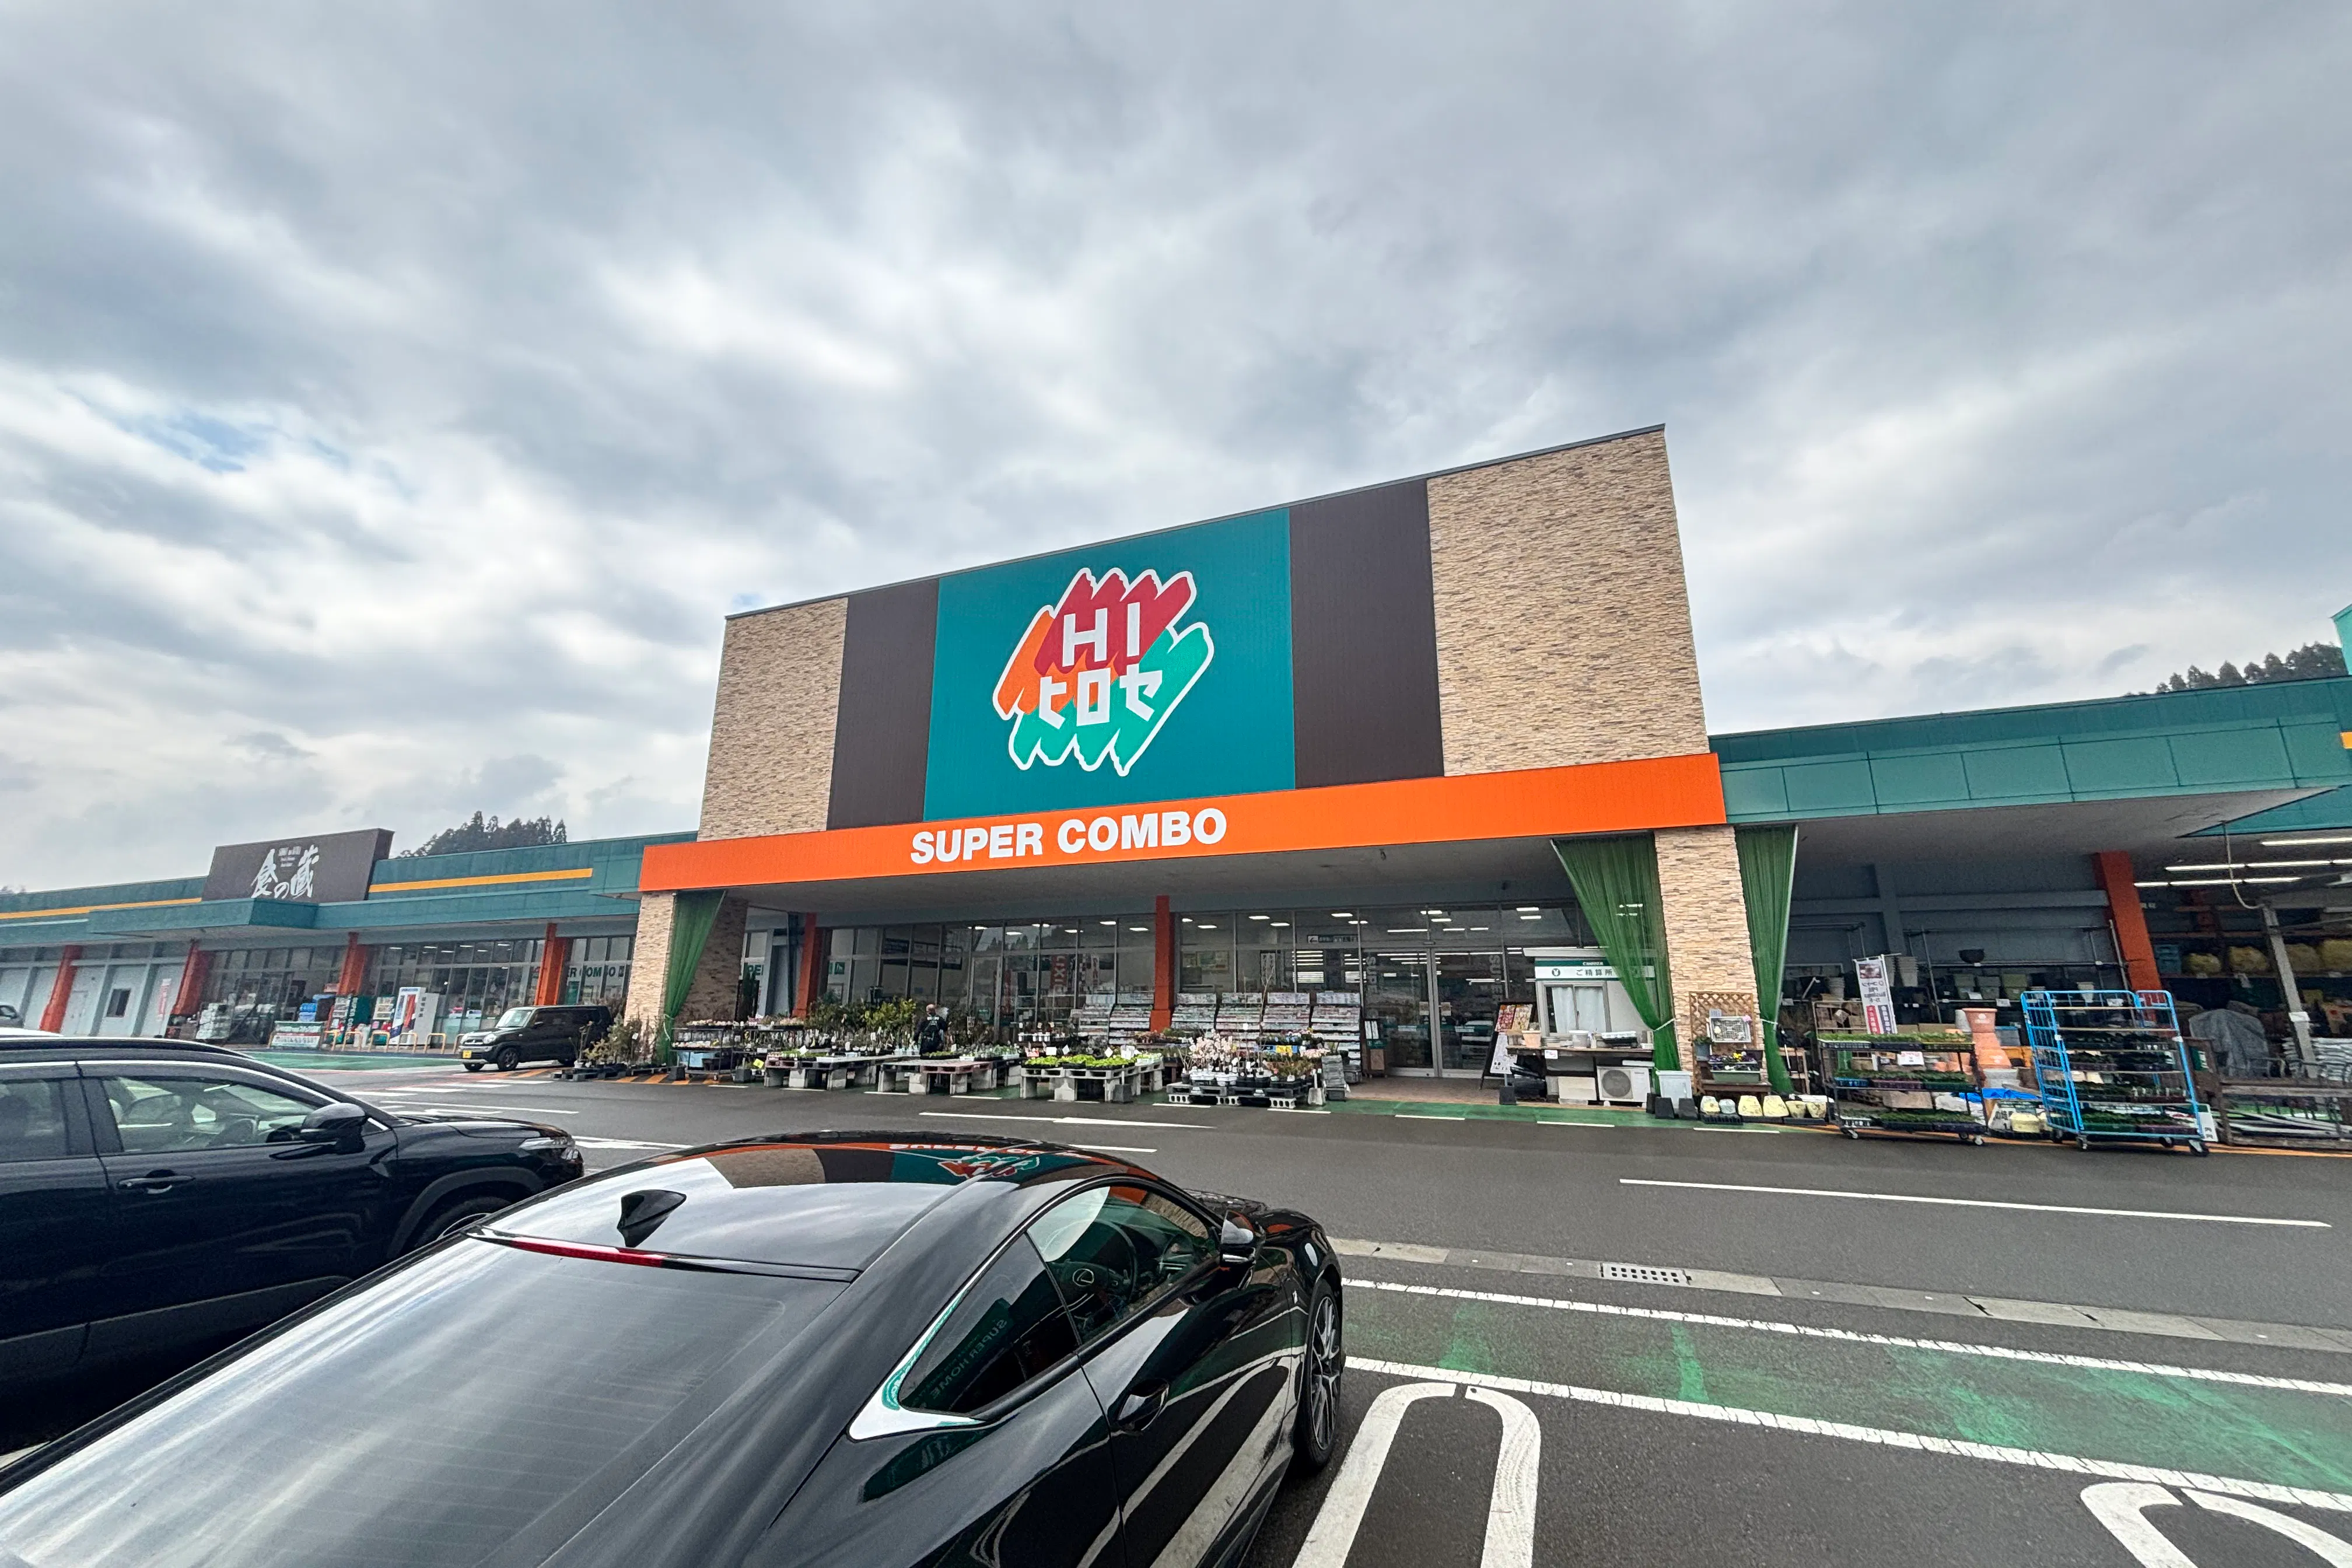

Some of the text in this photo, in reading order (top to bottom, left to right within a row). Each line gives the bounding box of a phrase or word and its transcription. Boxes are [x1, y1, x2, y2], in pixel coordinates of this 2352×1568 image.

[1062, 602, 1140, 667] HI
[1039, 663, 1163, 729] ヒロセ
[910, 808, 1227, 864] SUPER COMBO
